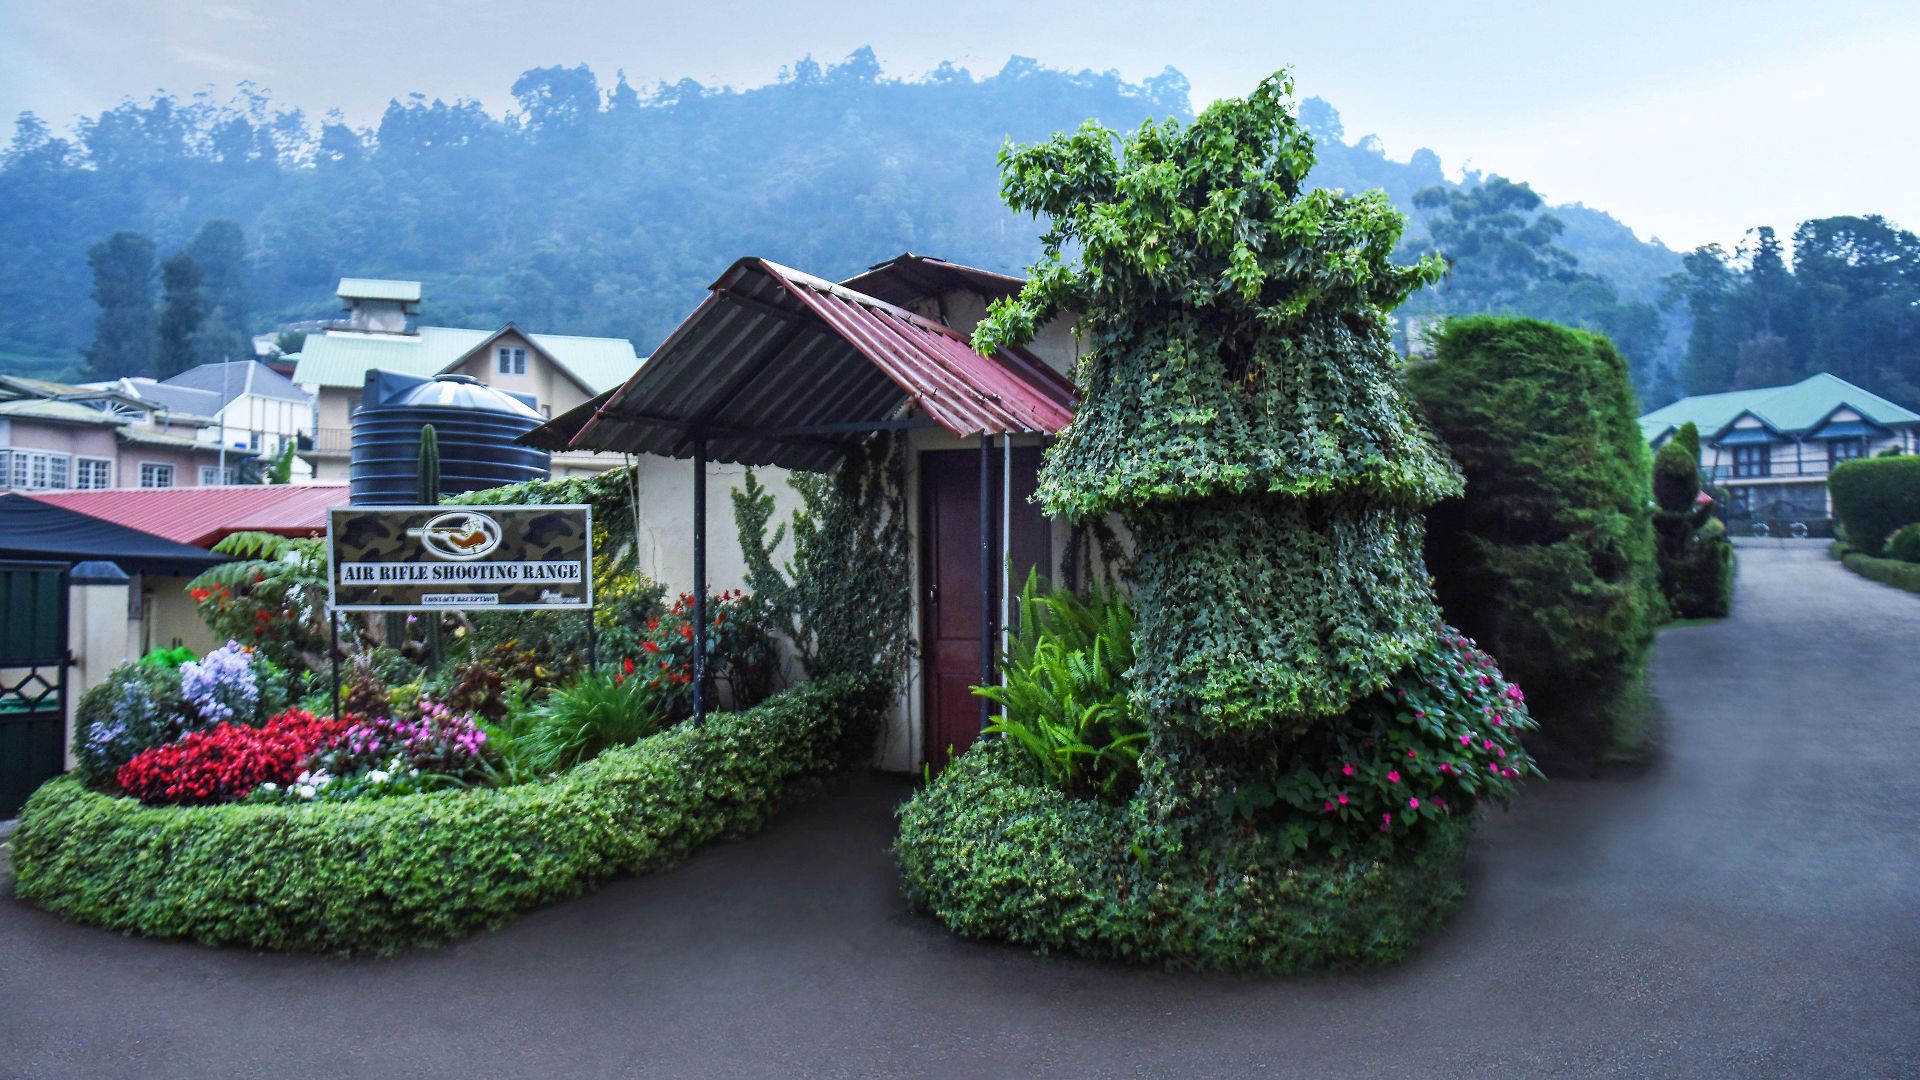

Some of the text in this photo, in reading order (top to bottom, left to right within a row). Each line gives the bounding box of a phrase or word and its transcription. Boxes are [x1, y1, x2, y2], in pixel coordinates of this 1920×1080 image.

[344, 563, 579, 581] AIR RIFLE SHOOTING RANGE
